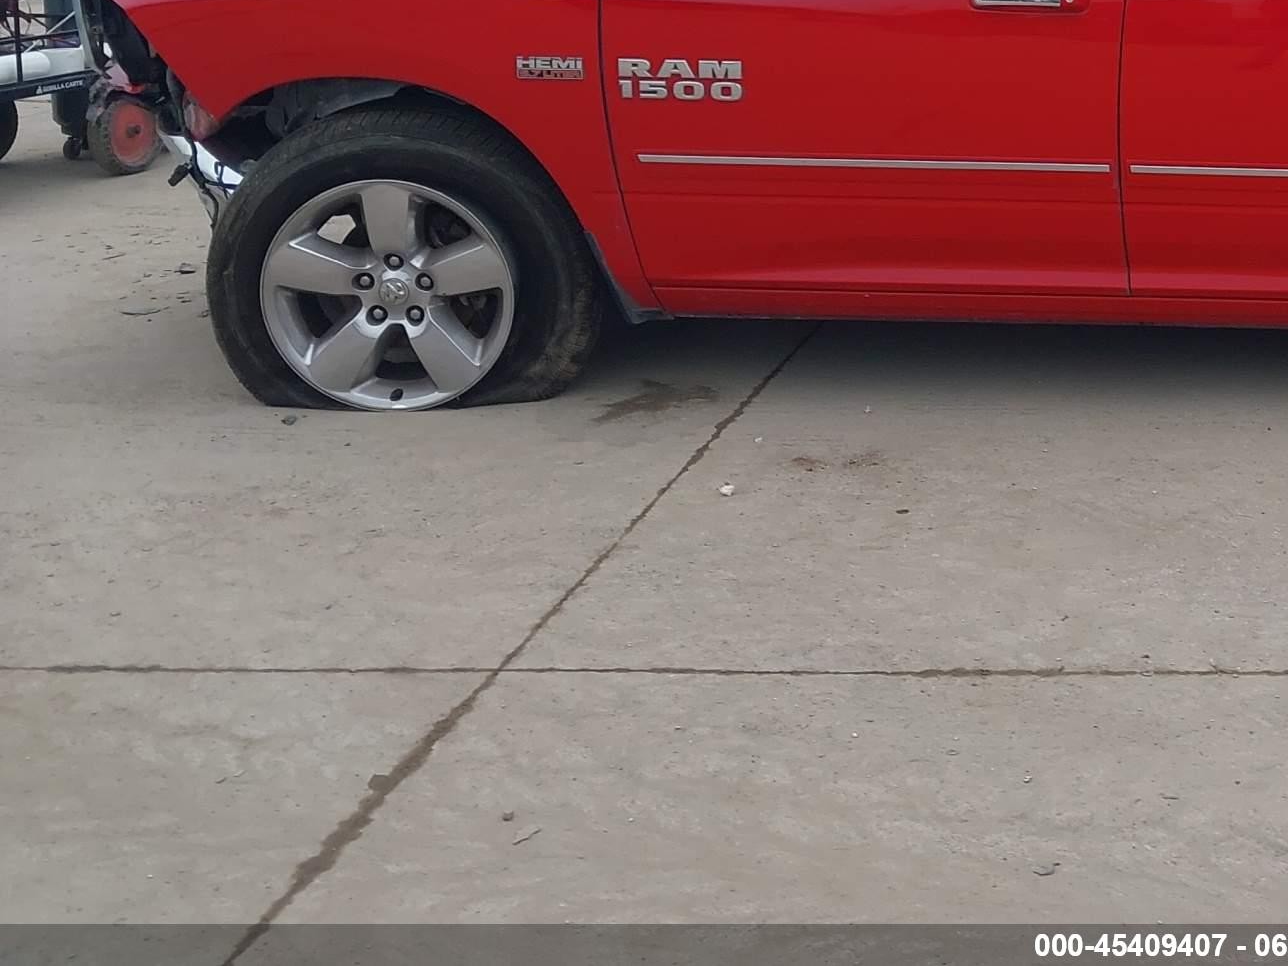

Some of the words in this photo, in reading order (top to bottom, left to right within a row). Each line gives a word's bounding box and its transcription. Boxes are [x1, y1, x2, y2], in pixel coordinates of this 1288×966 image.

[516, 56, 583, 70] HEMI
[617, 58, 743, 80] RAM
[618, 80, 743, 101] 1500
